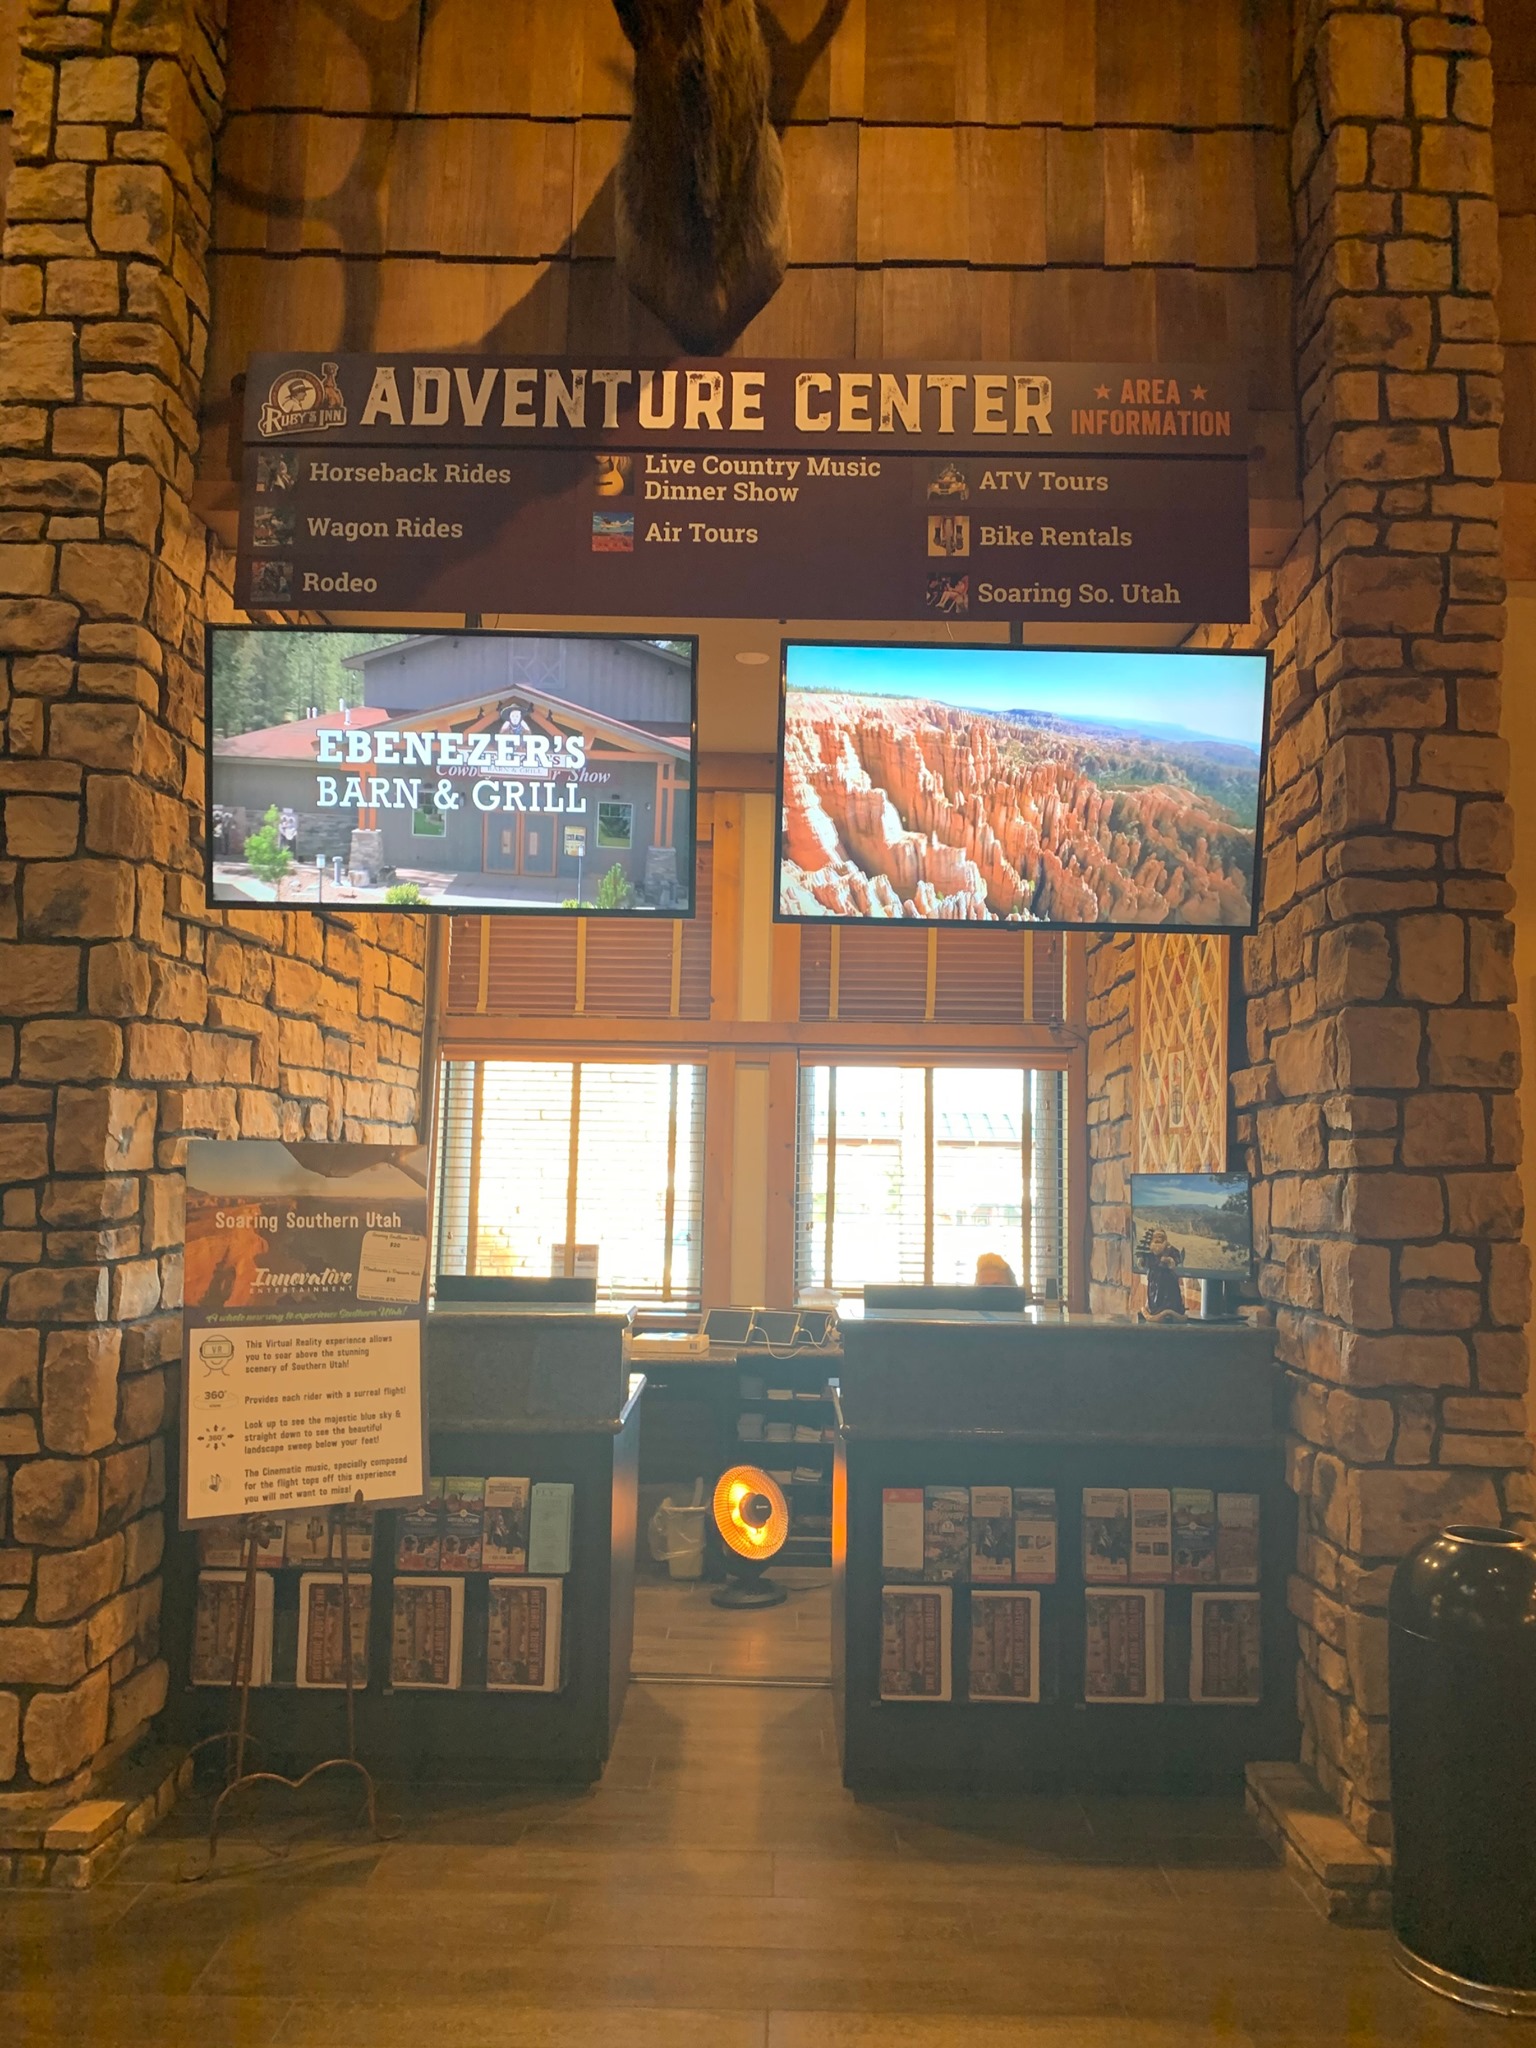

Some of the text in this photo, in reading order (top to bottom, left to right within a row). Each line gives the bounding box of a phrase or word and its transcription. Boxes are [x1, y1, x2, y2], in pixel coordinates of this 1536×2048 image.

[360, 366, 766, 431] ADVENTURE
[794, 372, 1053, 436] CENTER
[1120, 379, 1181, 405] AREA
[318, 409, 343, 427] INN
[1071, 409, 1231, 437] INFORMATION
[309, 462, 512, 485] Horseback Rides
[645, 455, 881, 480] Live Country Music
[645, 481, 799, 502] Dinner Show
[979, 471, 1110, 492] ATV Tours
[307, 517, 464, 542] Wagon Rides
[645, 523, 758, 543] Air Tours
[979, 526, 1133, 548] Bike Rentals
[303, 572, 378, 592] Rodeo
[978, 583, 1182, 607] Soaring So. Utah
[316, 728, 586, 770] EBENEZER'S
[316, 776, 587, 813] BARN & GRILL
[215, 1211, 402, 1233] Soaring Southern Utah
[250, 1267, 353, 1288] Innovative
[250, 1285, 353, 1294] ENTERTAINMENT
[293, 1311, 338, 1323] experience
[212, 1345, 222, 1354] VR
[246, 1335, 392, 1348] This Virtual Reality experience allows
[245, 1354, 260, 1363] you
[263, 1352, 271, 1360] to
[295, 1349, 317, 1358] above
[321, 1348, 334, 1357] the
[337, 1347, 369, 1357] stunning
[245, 1359, 350, 1374] scenery of Southern Utah!
[244, 1395, 278, 1404] Provides
[282, 1394, 300, 1402] each
[303, 1392, 322, 1401] rider
[326, 1391, 343, 1399] with
[354, 1387, 380, 1397] surreal
[384, 1386, 406, 1396] flight!
[244, 1410, 401, 1429] Look up to see the majestic blue sky &
[244, 1432, 277, 1442] straight
[280, 1430, 301, 1439] down
[304, 1429, 313, 1437] to
[332, 1426, 345, 1435] the
[348, 1424, 382, 1434] beautiful
[244, 1436, 380, 1454] landscape sweep below your feet!
[244, 1455, 408, 1478] The Cinematic music, specially composed
[244, 1469, 396, 1490] for the flight tops off this experience
[244, 1485, 351, 1505] you will not want to miss!
